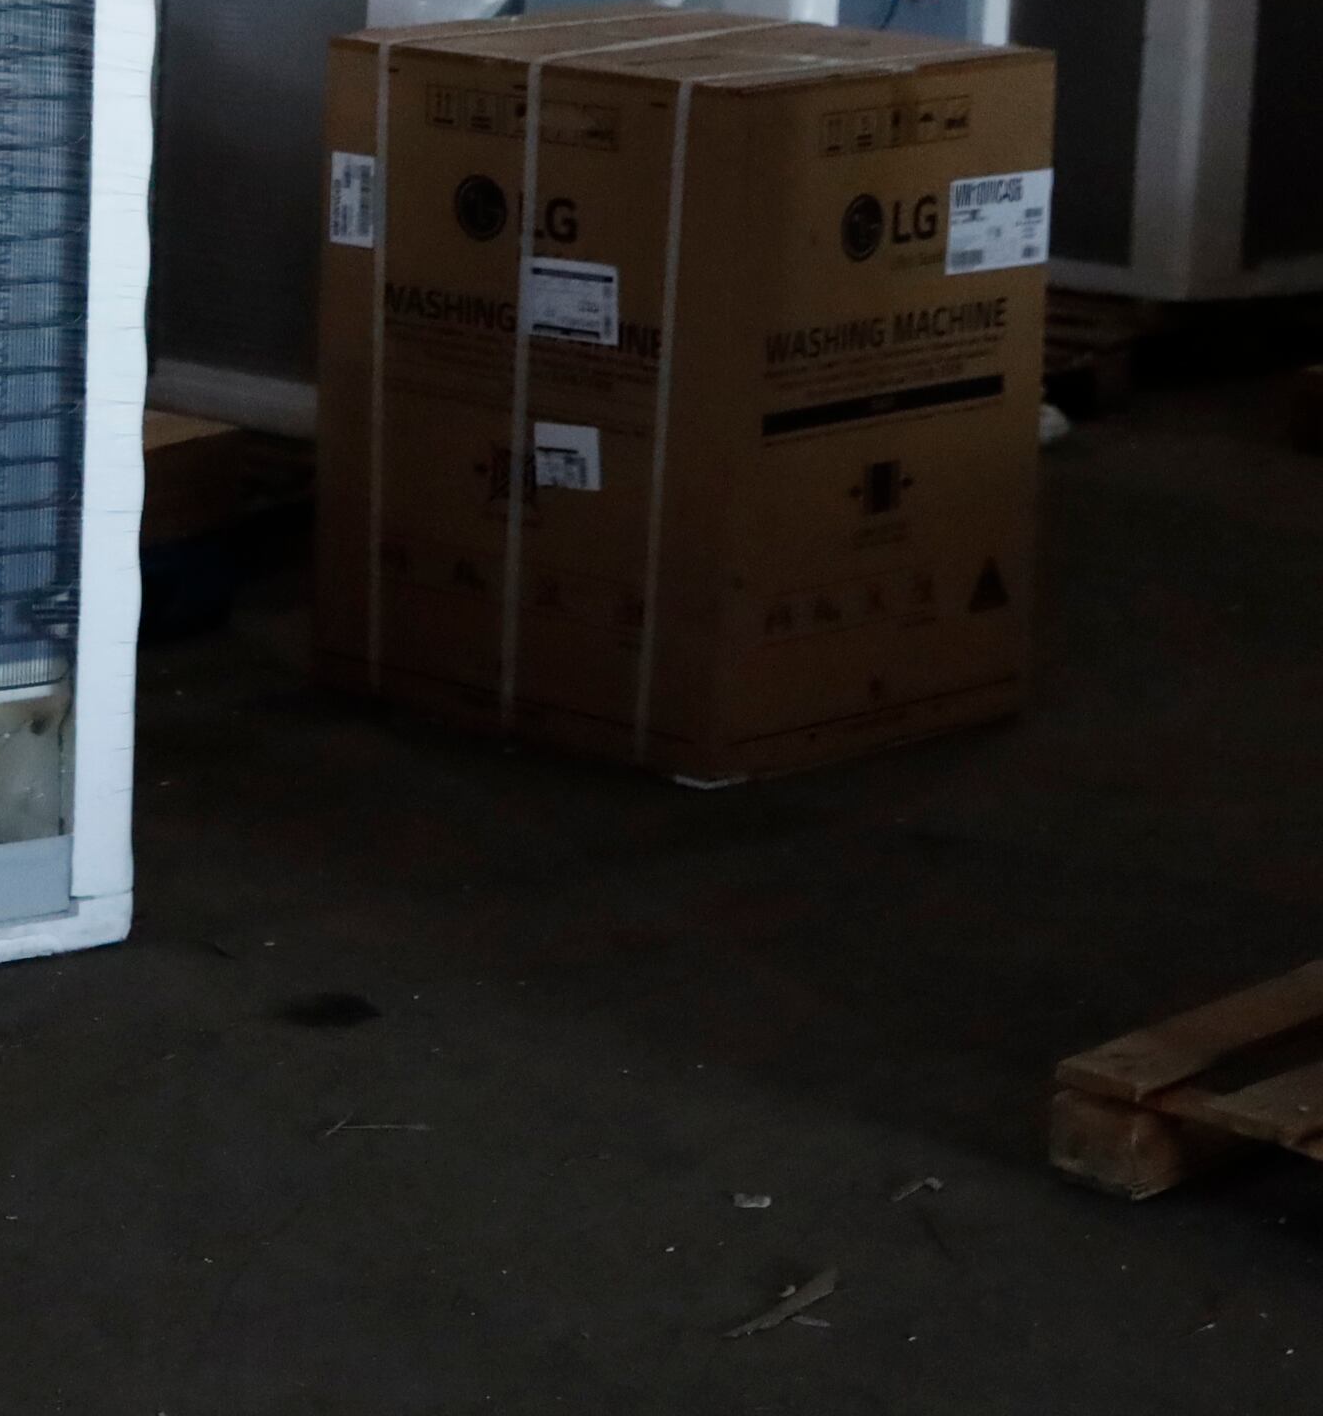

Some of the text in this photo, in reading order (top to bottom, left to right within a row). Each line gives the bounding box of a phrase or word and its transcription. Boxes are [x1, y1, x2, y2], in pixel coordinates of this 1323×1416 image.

[892, 195, 938, 244] LG
[764, 297, 1008, 364] WASHING MACHINE
